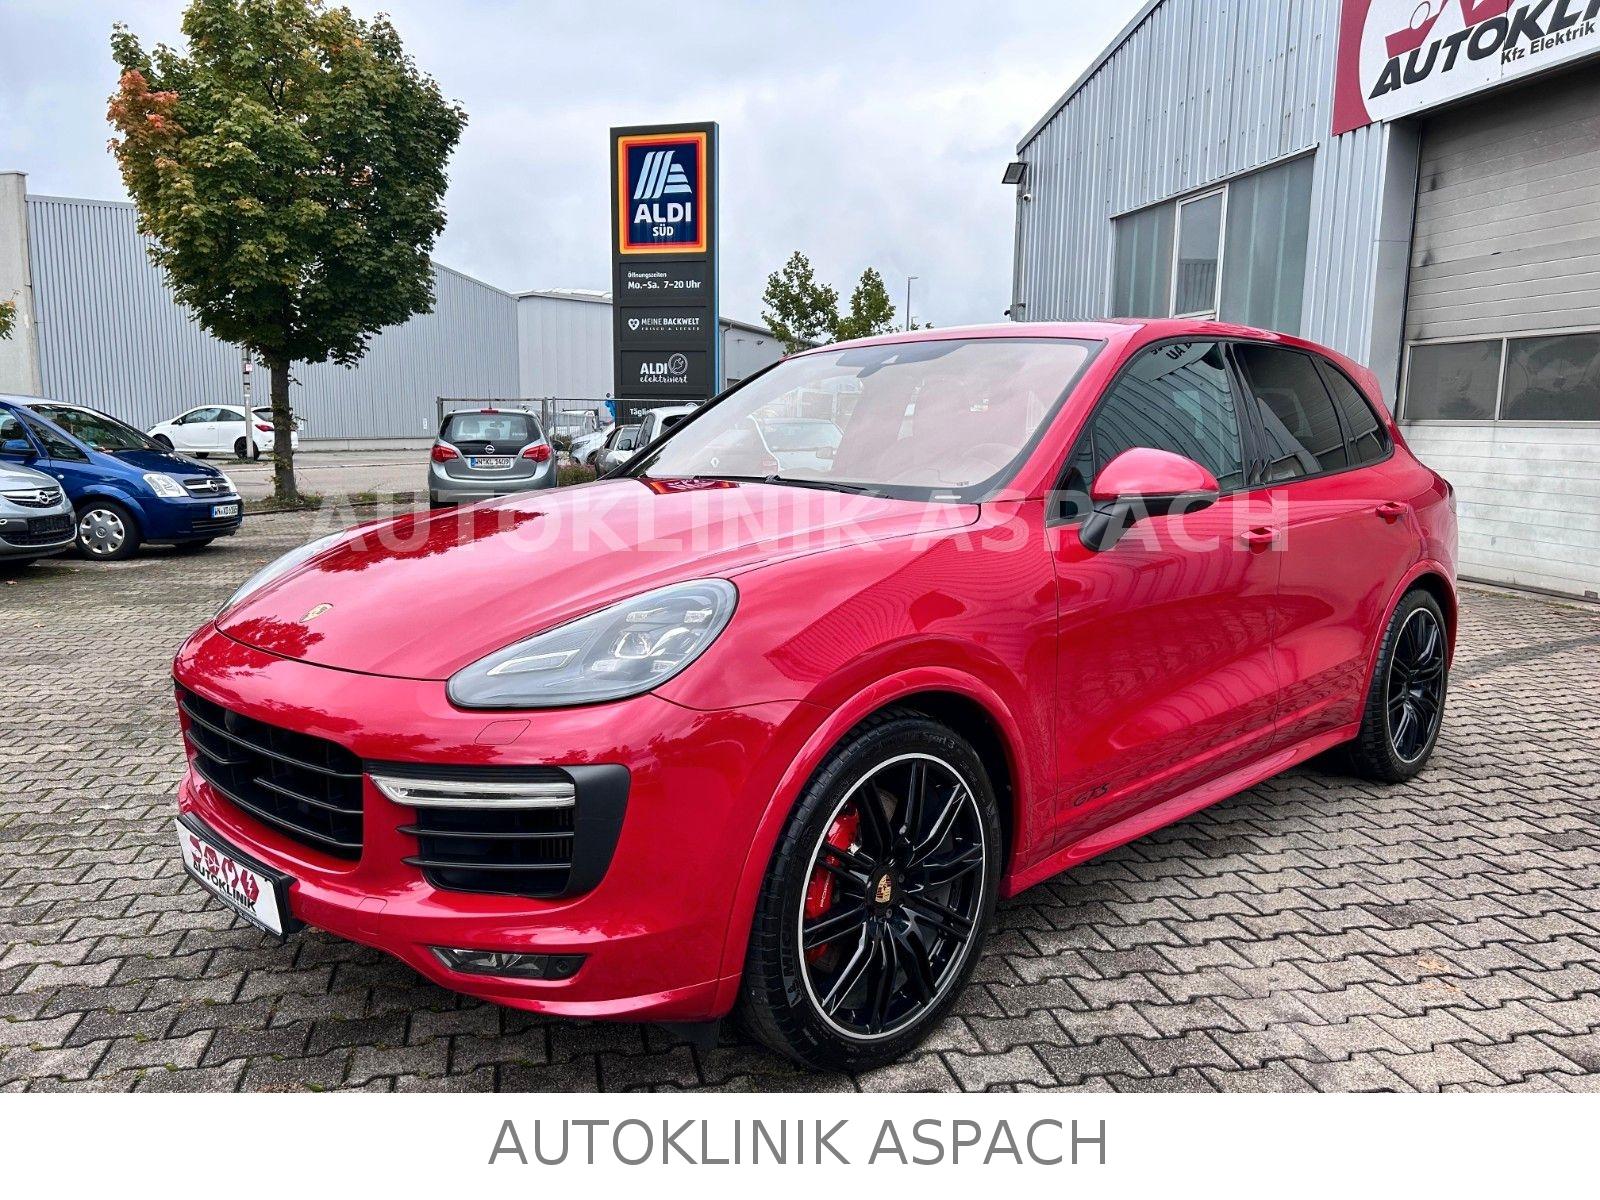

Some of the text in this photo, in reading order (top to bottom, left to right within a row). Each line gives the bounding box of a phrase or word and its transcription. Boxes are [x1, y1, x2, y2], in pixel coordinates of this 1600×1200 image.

[1501, 21, 1596, 65] Kfz Elektrik
[633, 202, 692, 224] ALDI
[652, 223, 674, 236] SÜD
[627, 271, 667, 279] Öffnungszeiten
[686, 279, 701, 289] Uhr
[641, 317, 700, 325] MEINE BACKWELT
[640, 362, 668, 374] ALDI
[194, 861, 257, 913] AUTOKLINIK
